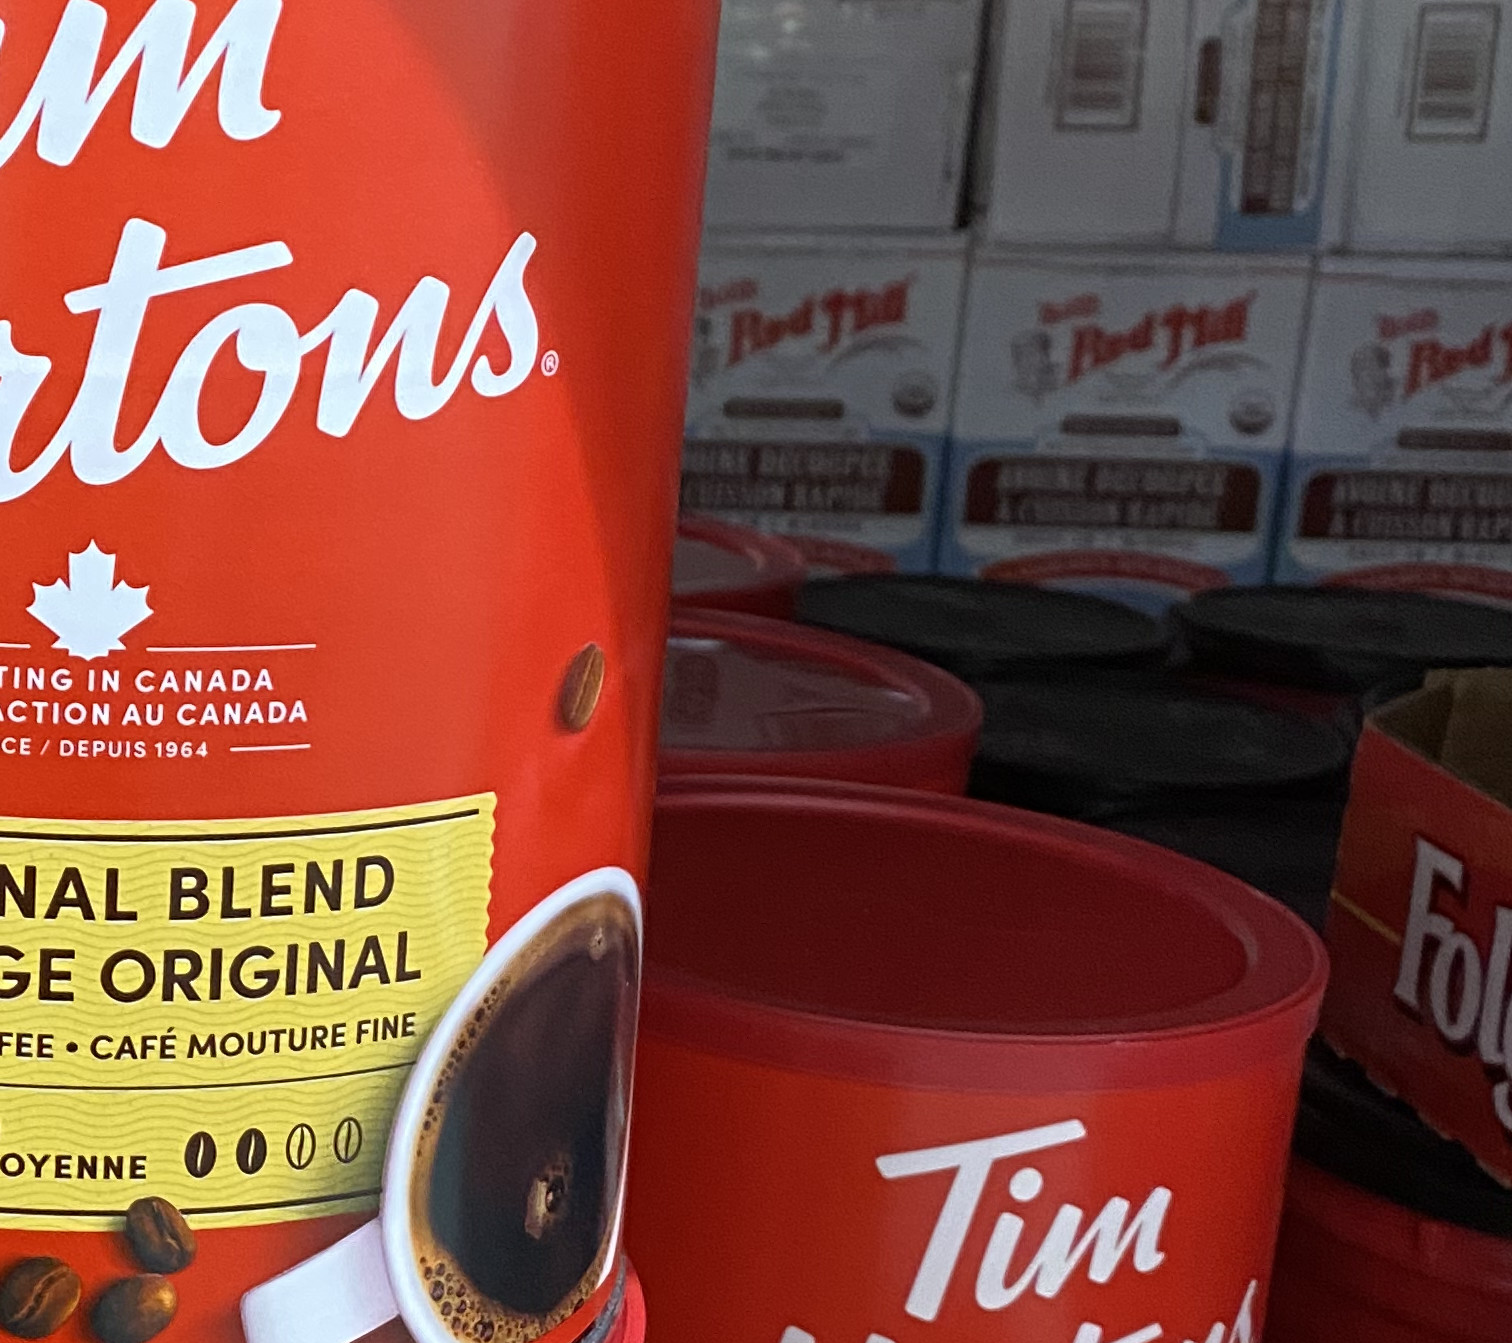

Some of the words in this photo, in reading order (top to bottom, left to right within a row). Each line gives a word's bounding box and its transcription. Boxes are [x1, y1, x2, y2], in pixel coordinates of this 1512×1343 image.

[89, 668, 119, 693] IN
[135, 668, 273, 693] CANADA
[122, 703, 164, 726] AU
[177, 699, 308, 726] CANADA
[60, 738, 146, 758] DEPUIS
[154, 741, 209, 758] 1964
[169, 855, 396, 922] BLEND
[101, 931, 421, 1003] ORIGINAL
[89, 1026, 177, 1060] CAFÉ
[187, 1022, 347, 1059] MOUTURE
[355, 1012, 416, 1044] FINE
[875, 1119, 1172, 1323] Tim
